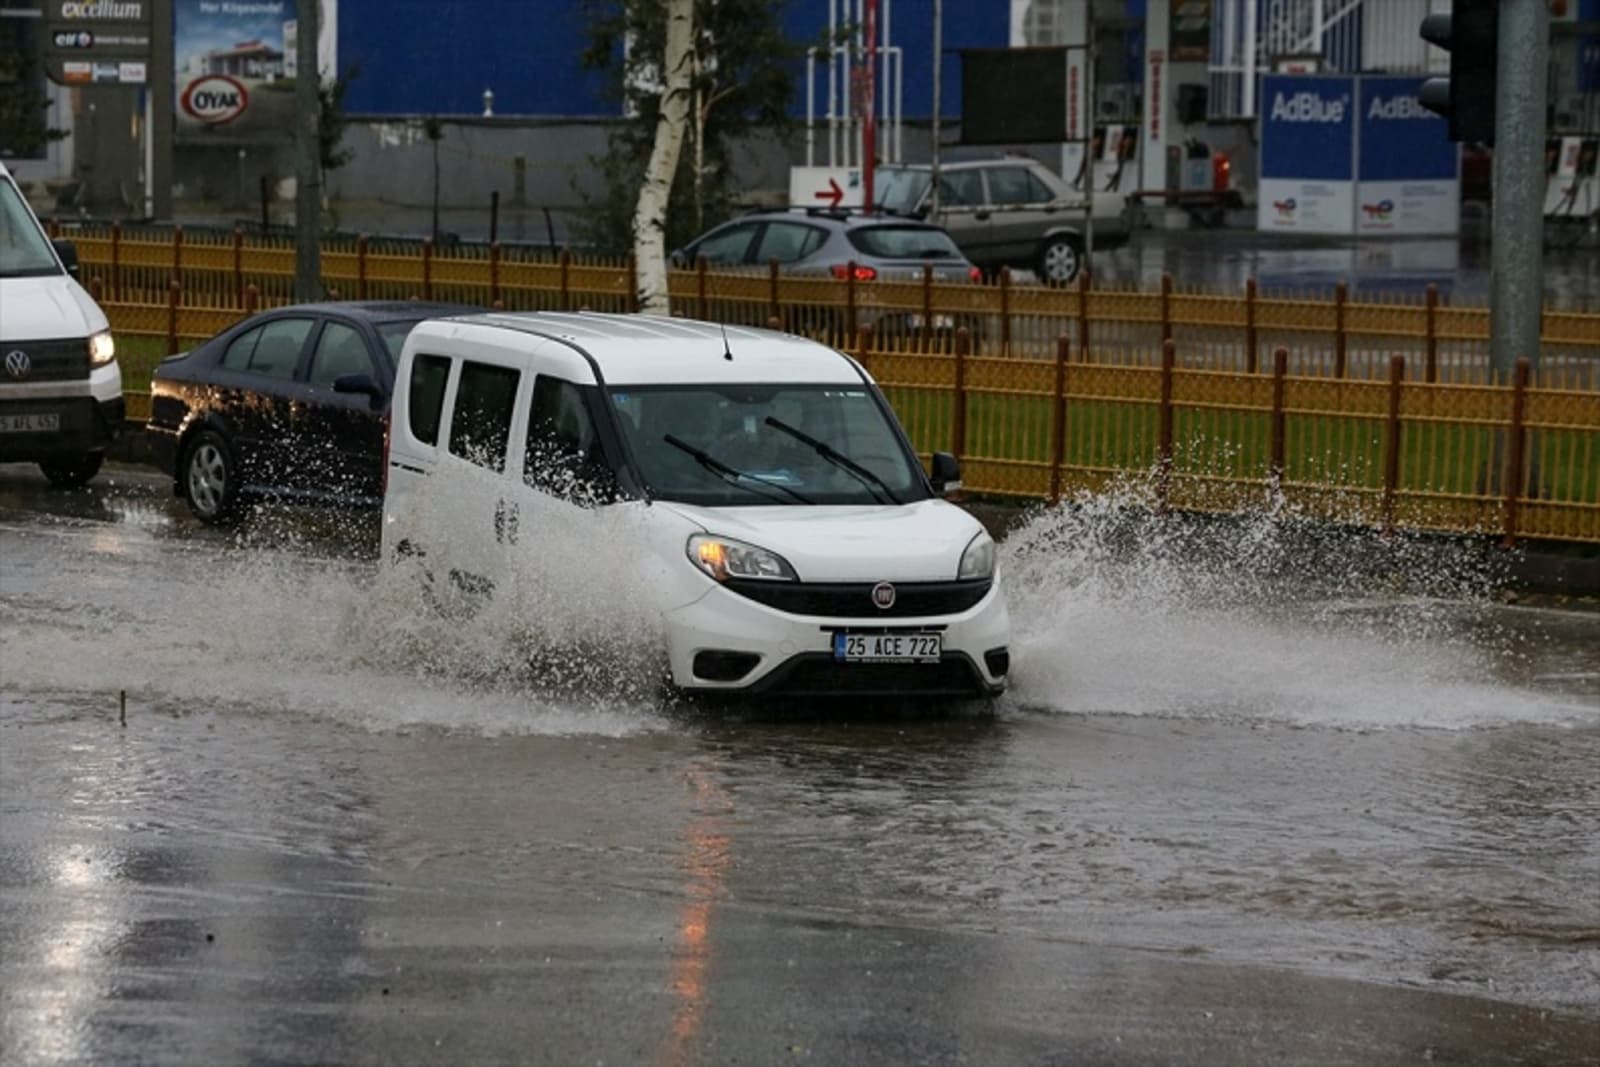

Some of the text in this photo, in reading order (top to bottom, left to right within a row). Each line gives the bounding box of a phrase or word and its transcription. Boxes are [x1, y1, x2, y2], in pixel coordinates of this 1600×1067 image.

[62, 0, 141, 19] excellium
[55, 34, 77, 47] elf
[195, 92, 239, 109] OYAK
[848, 638, 938, 655] 25 ACE 722
